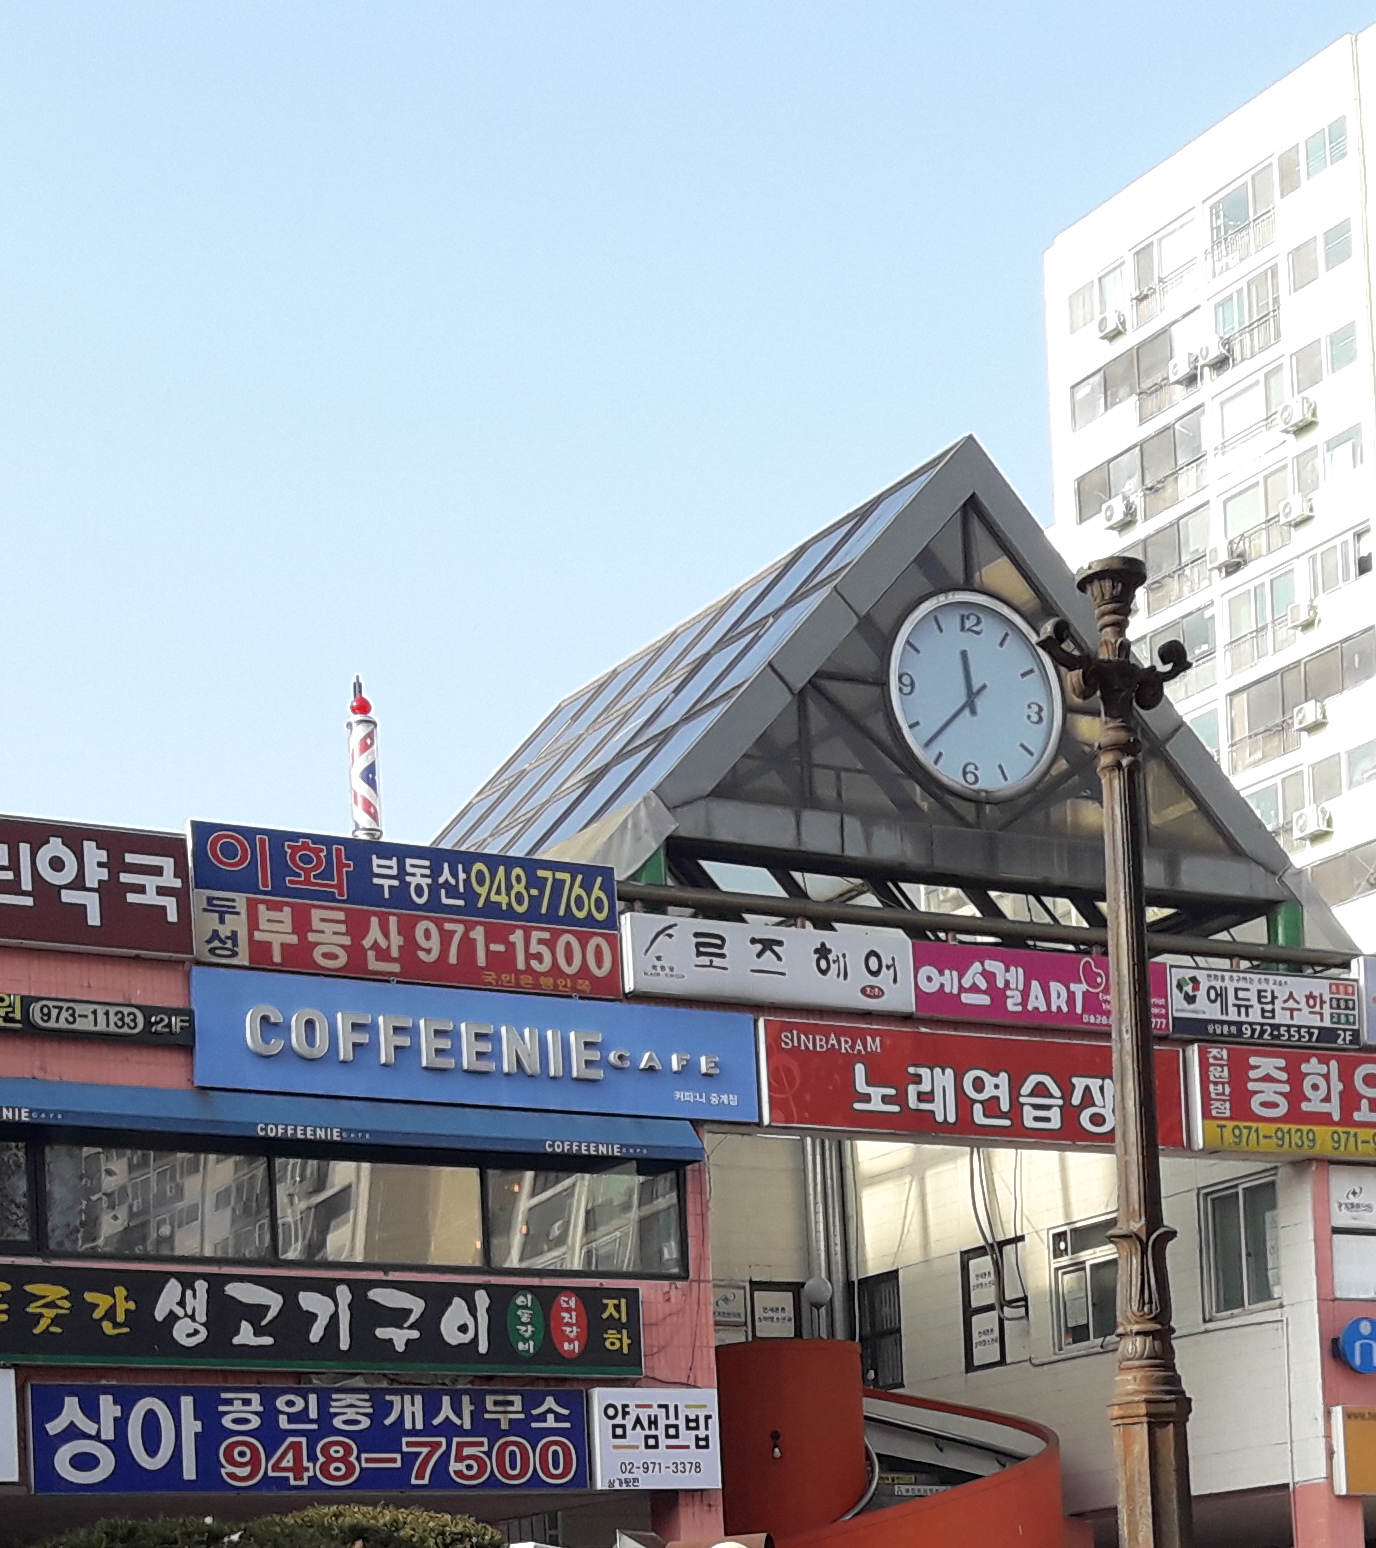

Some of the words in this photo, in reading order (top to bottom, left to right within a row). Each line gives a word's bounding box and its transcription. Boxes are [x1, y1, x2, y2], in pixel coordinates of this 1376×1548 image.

[960, 612, 982, 636] 12
[898, 671, 916, 696] 9
[1026, 702, 1044, 725] 3
[961, 761, 980, 785] 6
[206, 829, 354, 900] 이화
[370, 853, 467, 907] 부동산
[470, 861, 610, 921] 948-7766
[202, 895, 241, 958] 두성
[252, 903, 404, 973] 부동산
[414, 919, 613, 978] 971-1500
[691, 930, 899, 986] 로즈헤어
[38, 1004, 139, 1030] 973-1133
[1206, 984, 1327, 1023] 에듀탑수학
[245, 1004, 605, 1082] COFFEENIE
[607, 1050, 721, 1077] CAFE
[780, 1030, 881, 1054] SINBARAM
[1241, 1023, 1320, 1043] 972-5557
[1336, 1030, 1354, 1045] 2F
[256, 1123, 342, 1141] COFFEENIE
[545, 1140, 622, 1156] COFFEENIE
[154, 1276, 490, 1355] 생고기구이
[600, 1297, 632, 1355] 지하
[218, 1391, 573, 1432] 공인중개사무소
[602, 1402, 714, 1450] 얌샘김밥
[43, 1392, 204, 1484] 상아
[220, 1435, 579, 1487] 948-7500
[619, 1460, 703, 1475] 02-971-3378
